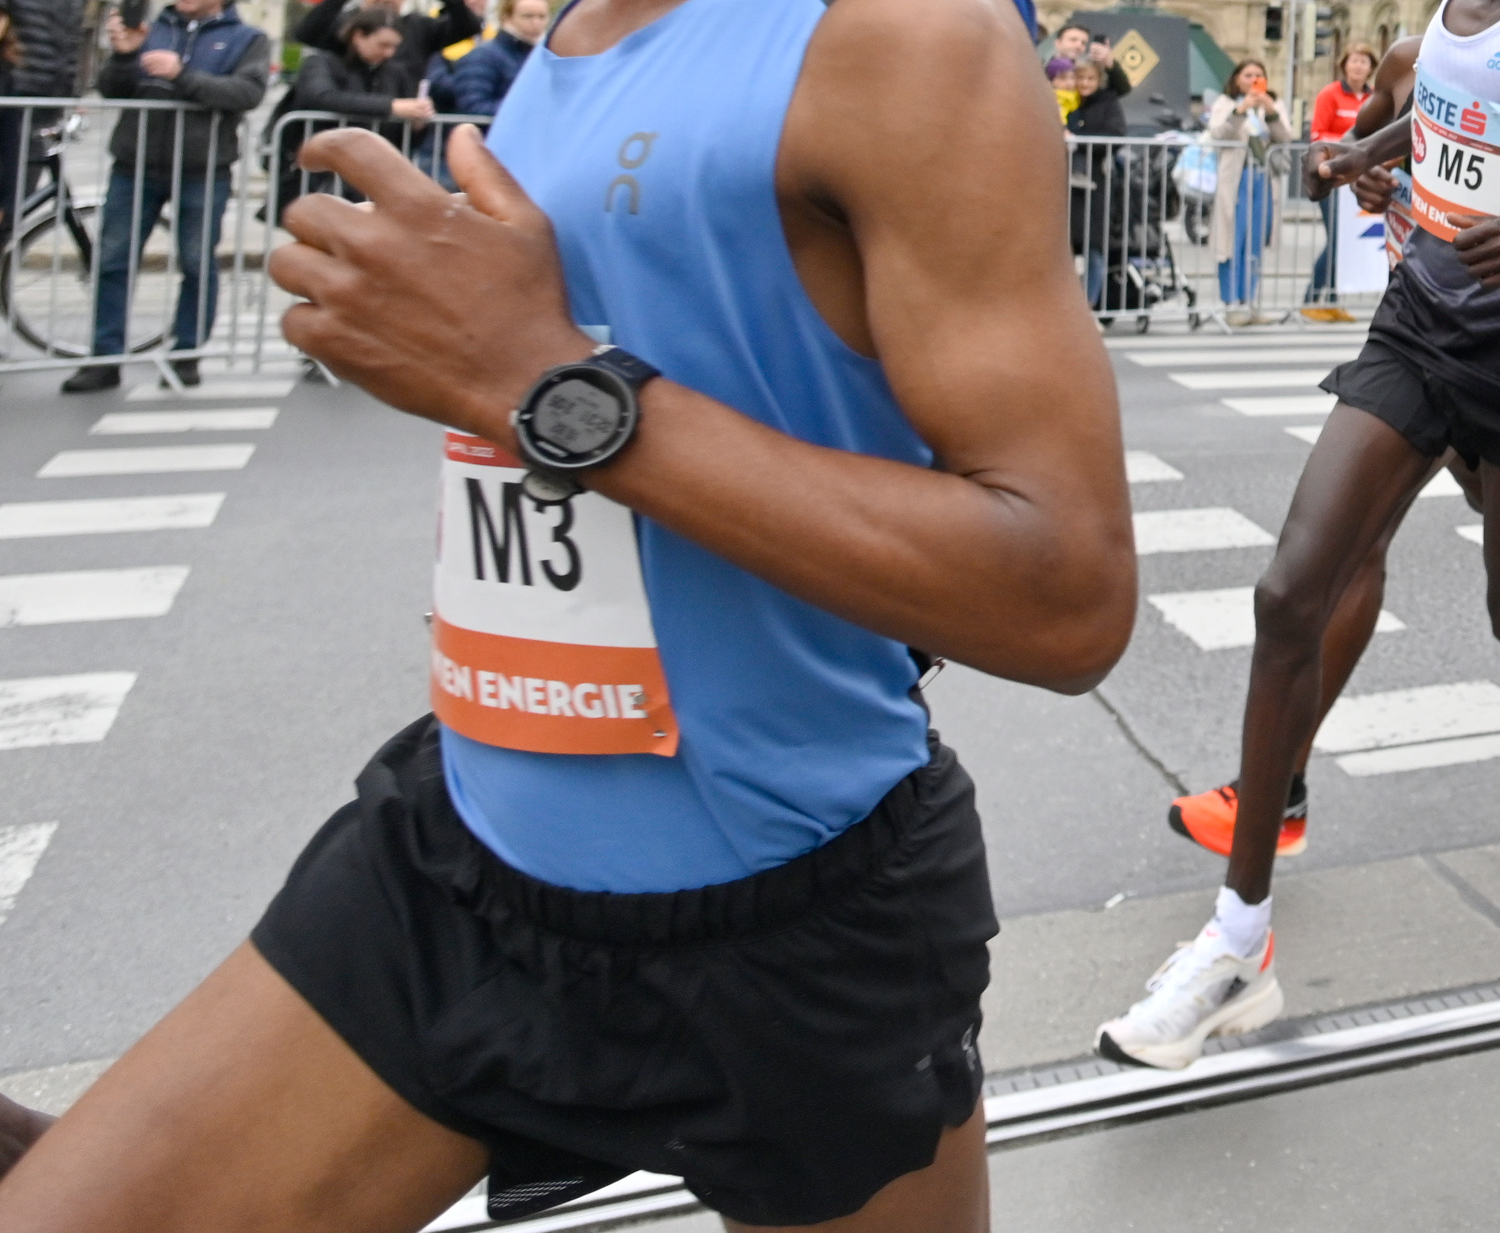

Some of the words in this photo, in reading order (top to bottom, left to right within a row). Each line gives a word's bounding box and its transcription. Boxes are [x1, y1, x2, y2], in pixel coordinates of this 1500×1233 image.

[1417, 81, 1458, 127] ERSTE
[1437, 142, 1485, 191] M5
[464, 477, 582, 592] M3
[477, 670, 648, 719] ENERGIE
